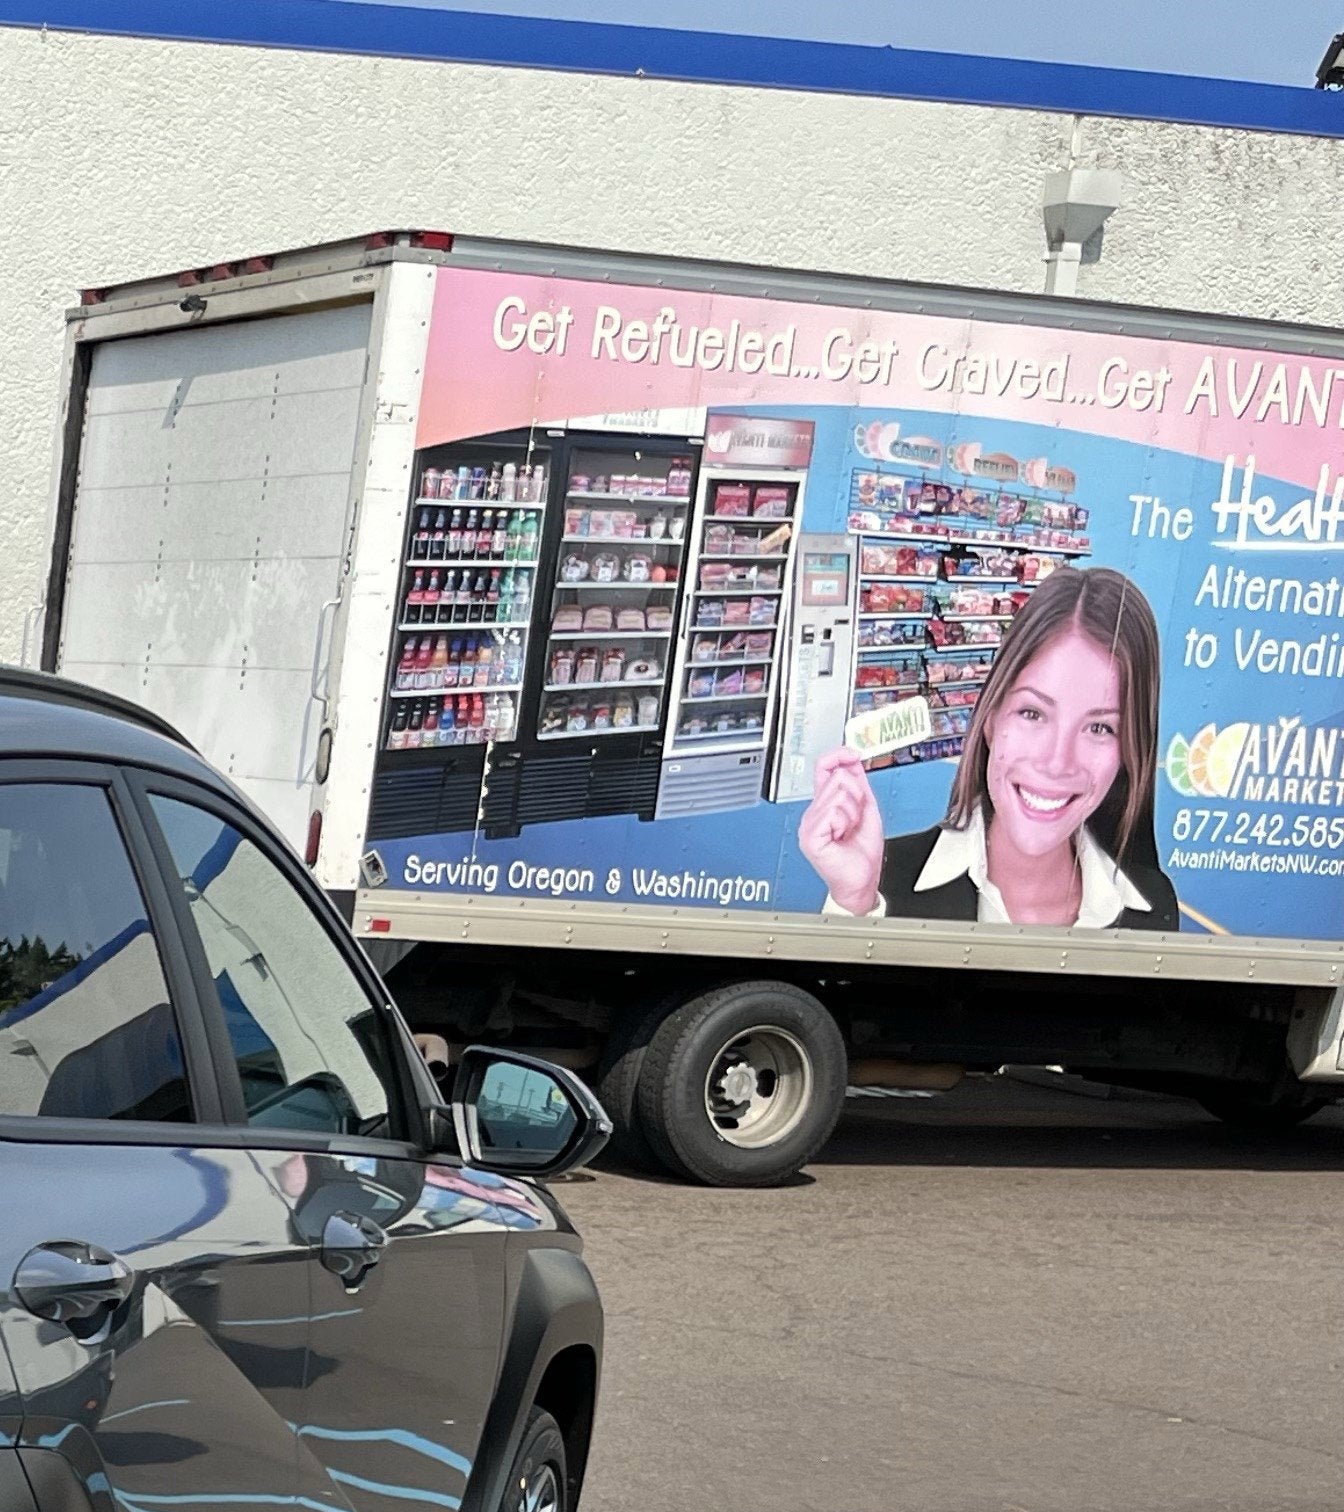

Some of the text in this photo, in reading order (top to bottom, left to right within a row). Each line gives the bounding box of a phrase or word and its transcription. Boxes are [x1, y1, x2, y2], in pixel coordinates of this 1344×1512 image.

[492, 296, 574, 356] Get
[1128, 494, 1194, 541] The
[1184, 627, 1218, 669] to
[404, 854, 770, 905] Serving Oregon & Washington
